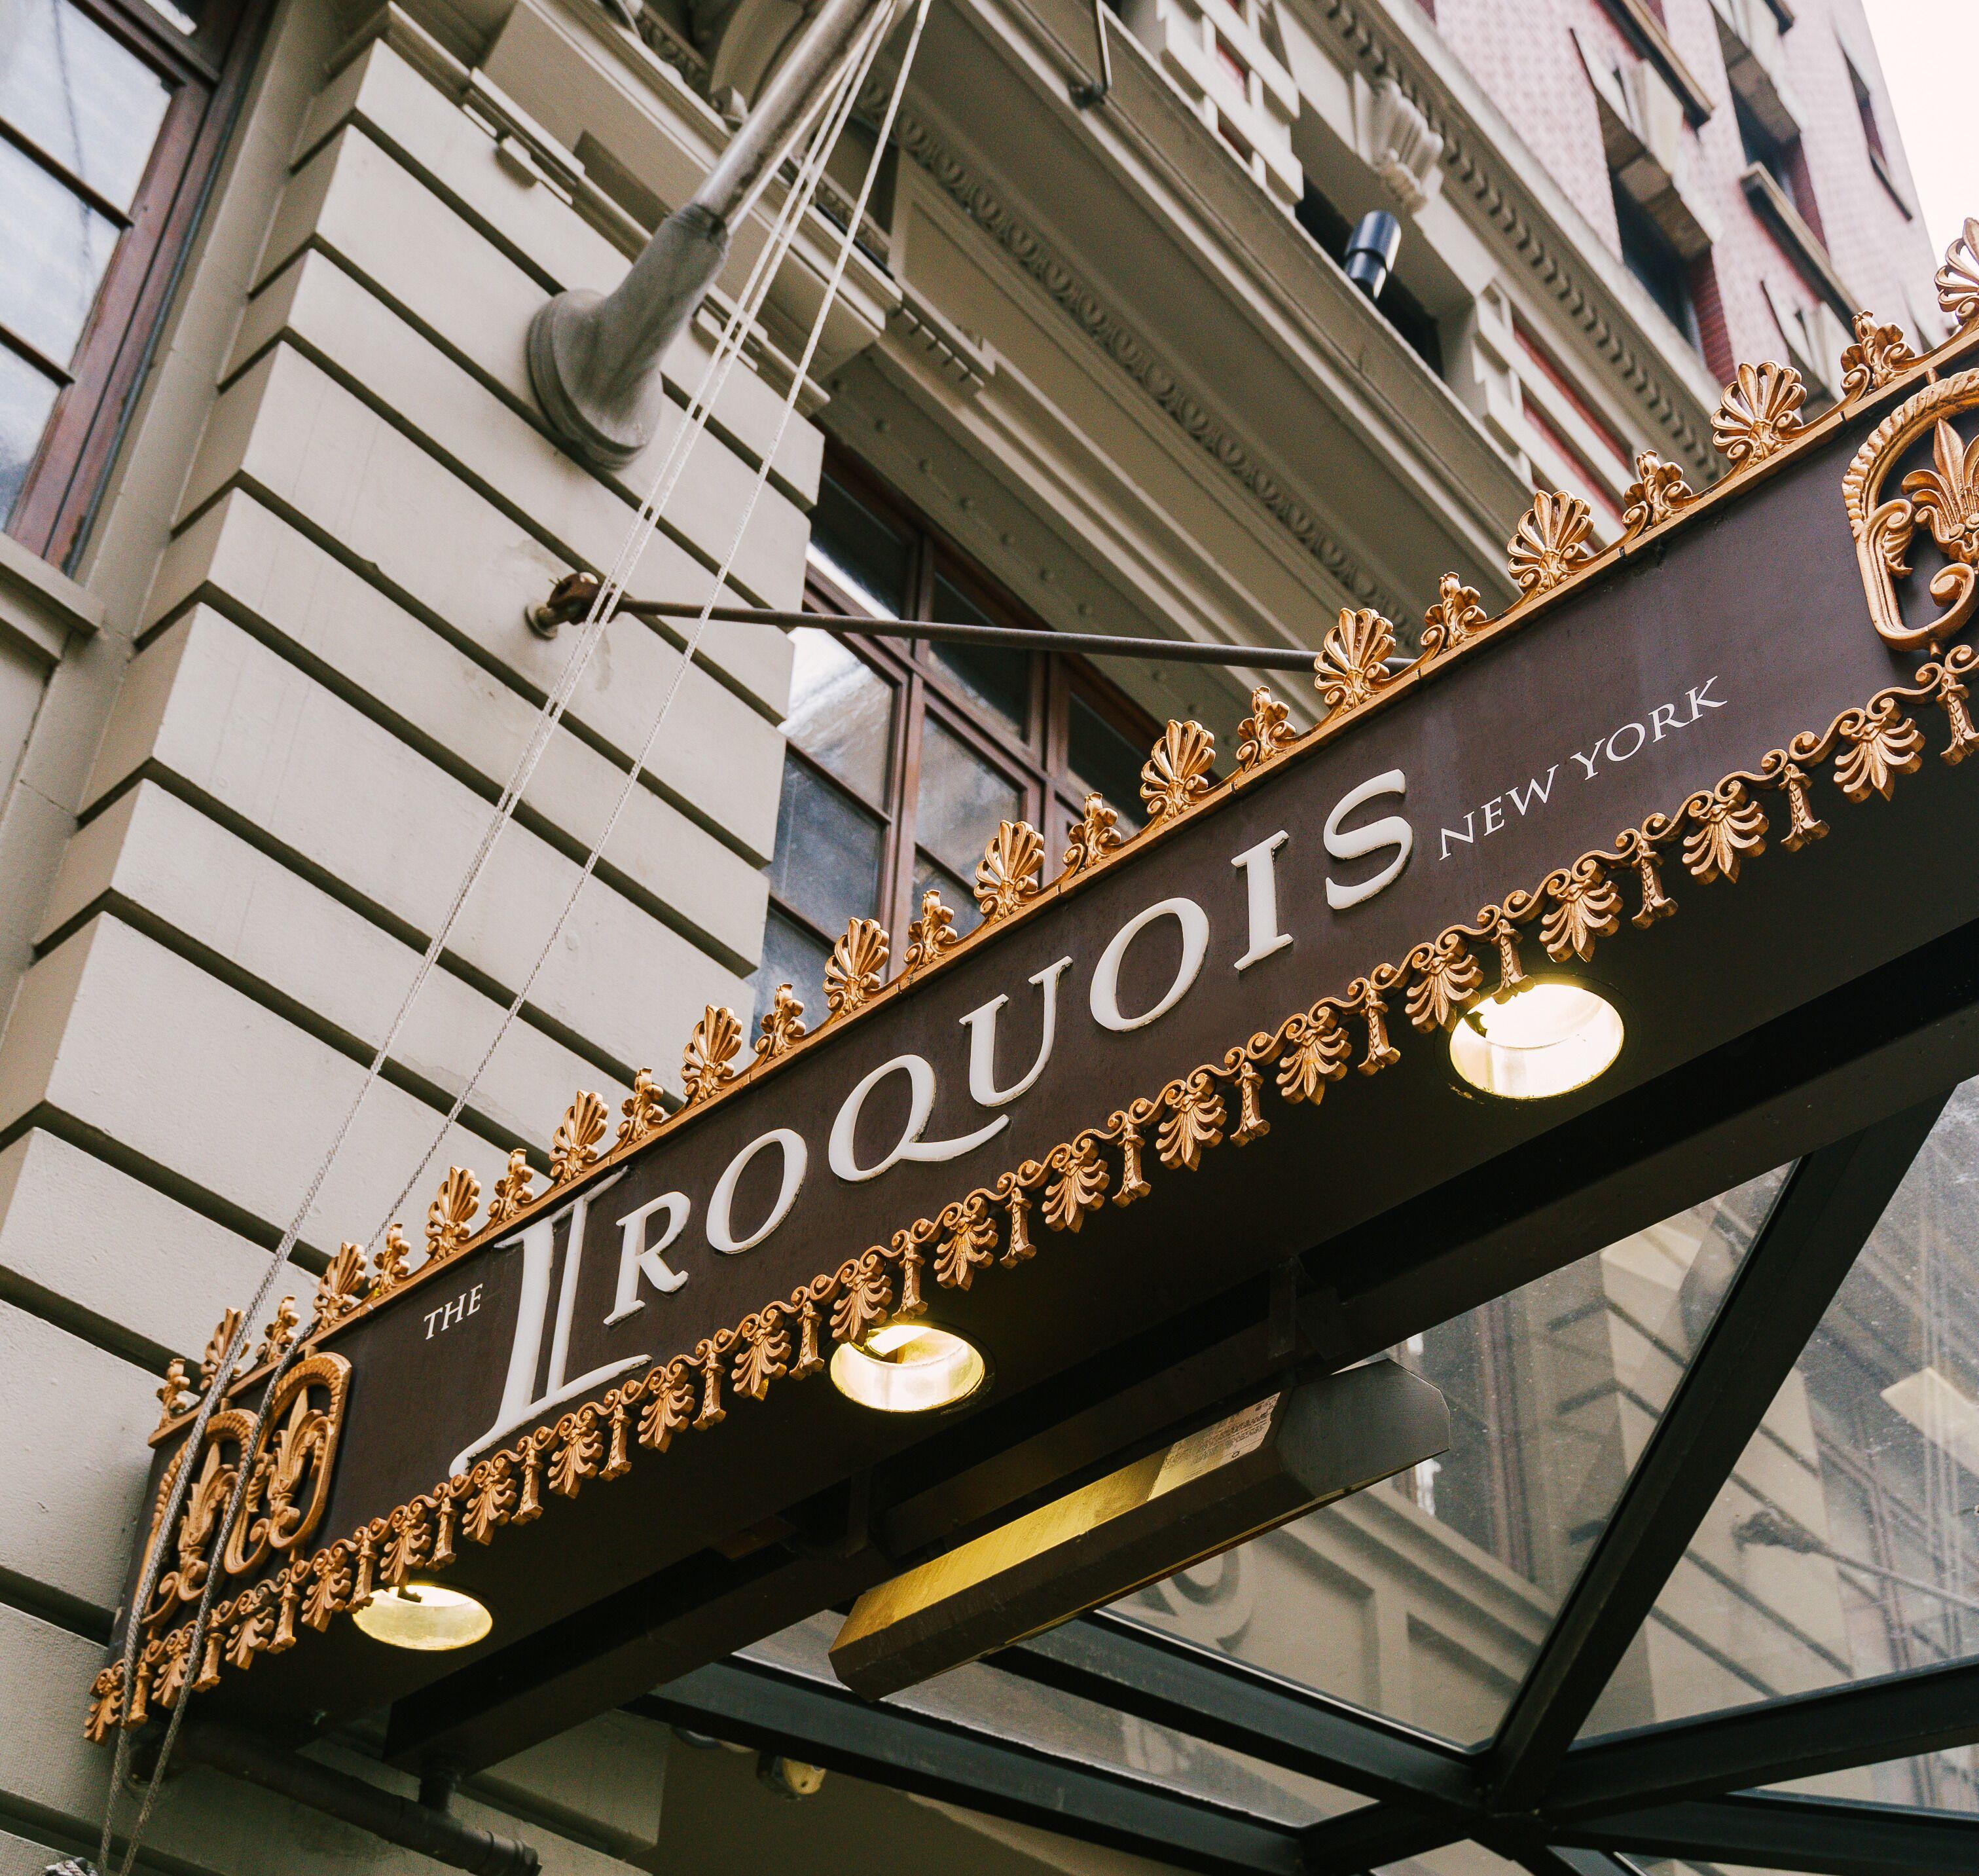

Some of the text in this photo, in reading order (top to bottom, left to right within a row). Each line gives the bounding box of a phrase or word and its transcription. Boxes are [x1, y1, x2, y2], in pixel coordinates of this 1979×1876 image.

[1570, 675, 1728, 781] YORK
[1439, 764, 1559, 860] NEW
[448, 769, 1413, 1479] IROQUOIS
[424, 1283, 483, 1340] THE
